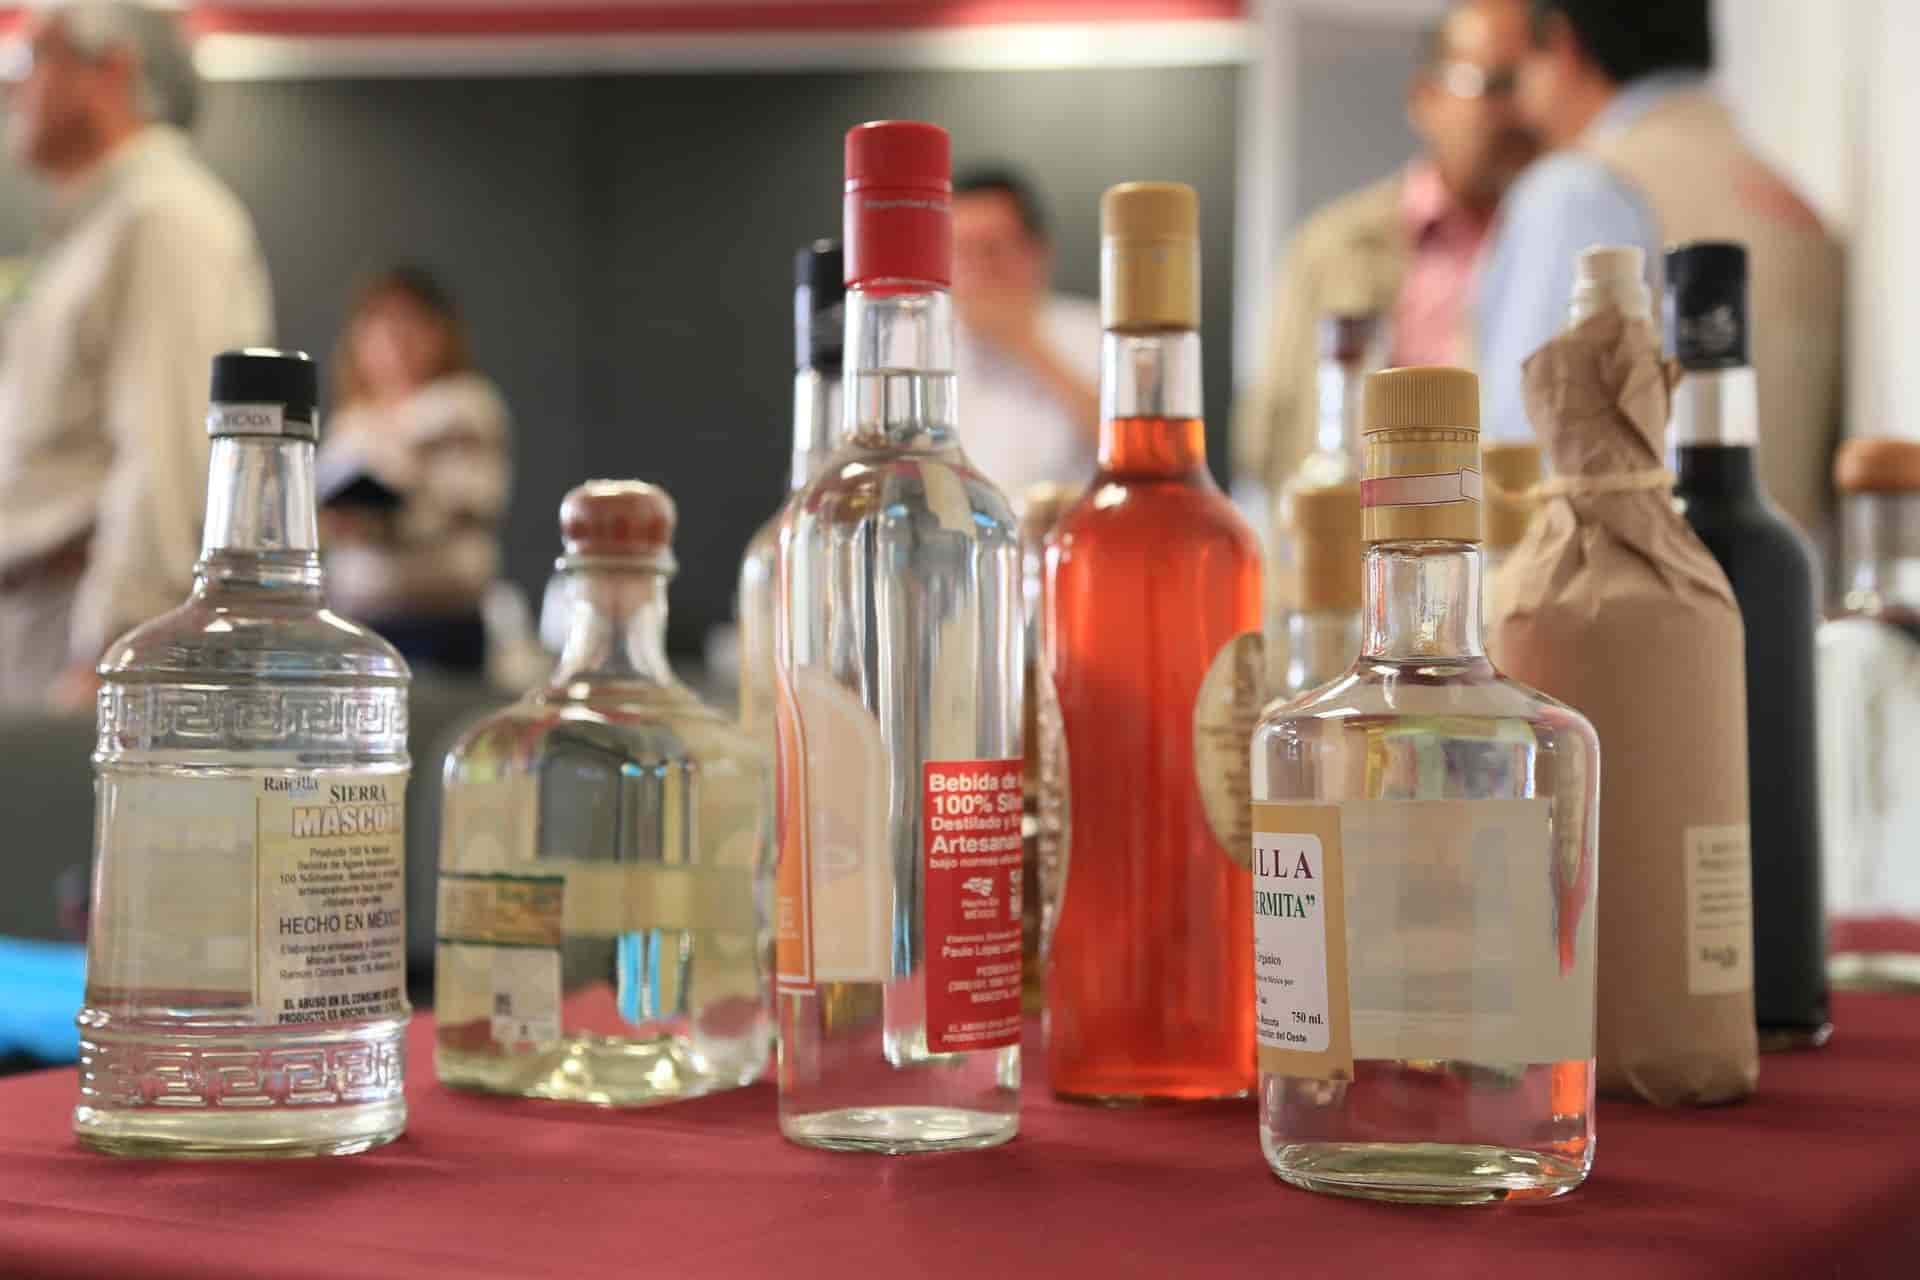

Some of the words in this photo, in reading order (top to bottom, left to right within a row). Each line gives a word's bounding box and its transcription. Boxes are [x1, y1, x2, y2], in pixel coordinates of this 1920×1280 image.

[929, 773, 999, 792] Bebida
[932, 794, 993, 815] 100%
[280, 913, 340, 935] HECHO
[343, 912, 363, 931] EN
[278, 1009, 326, 1024] PRODUCTO
[1291, 1010, 1306, 1025] 750
